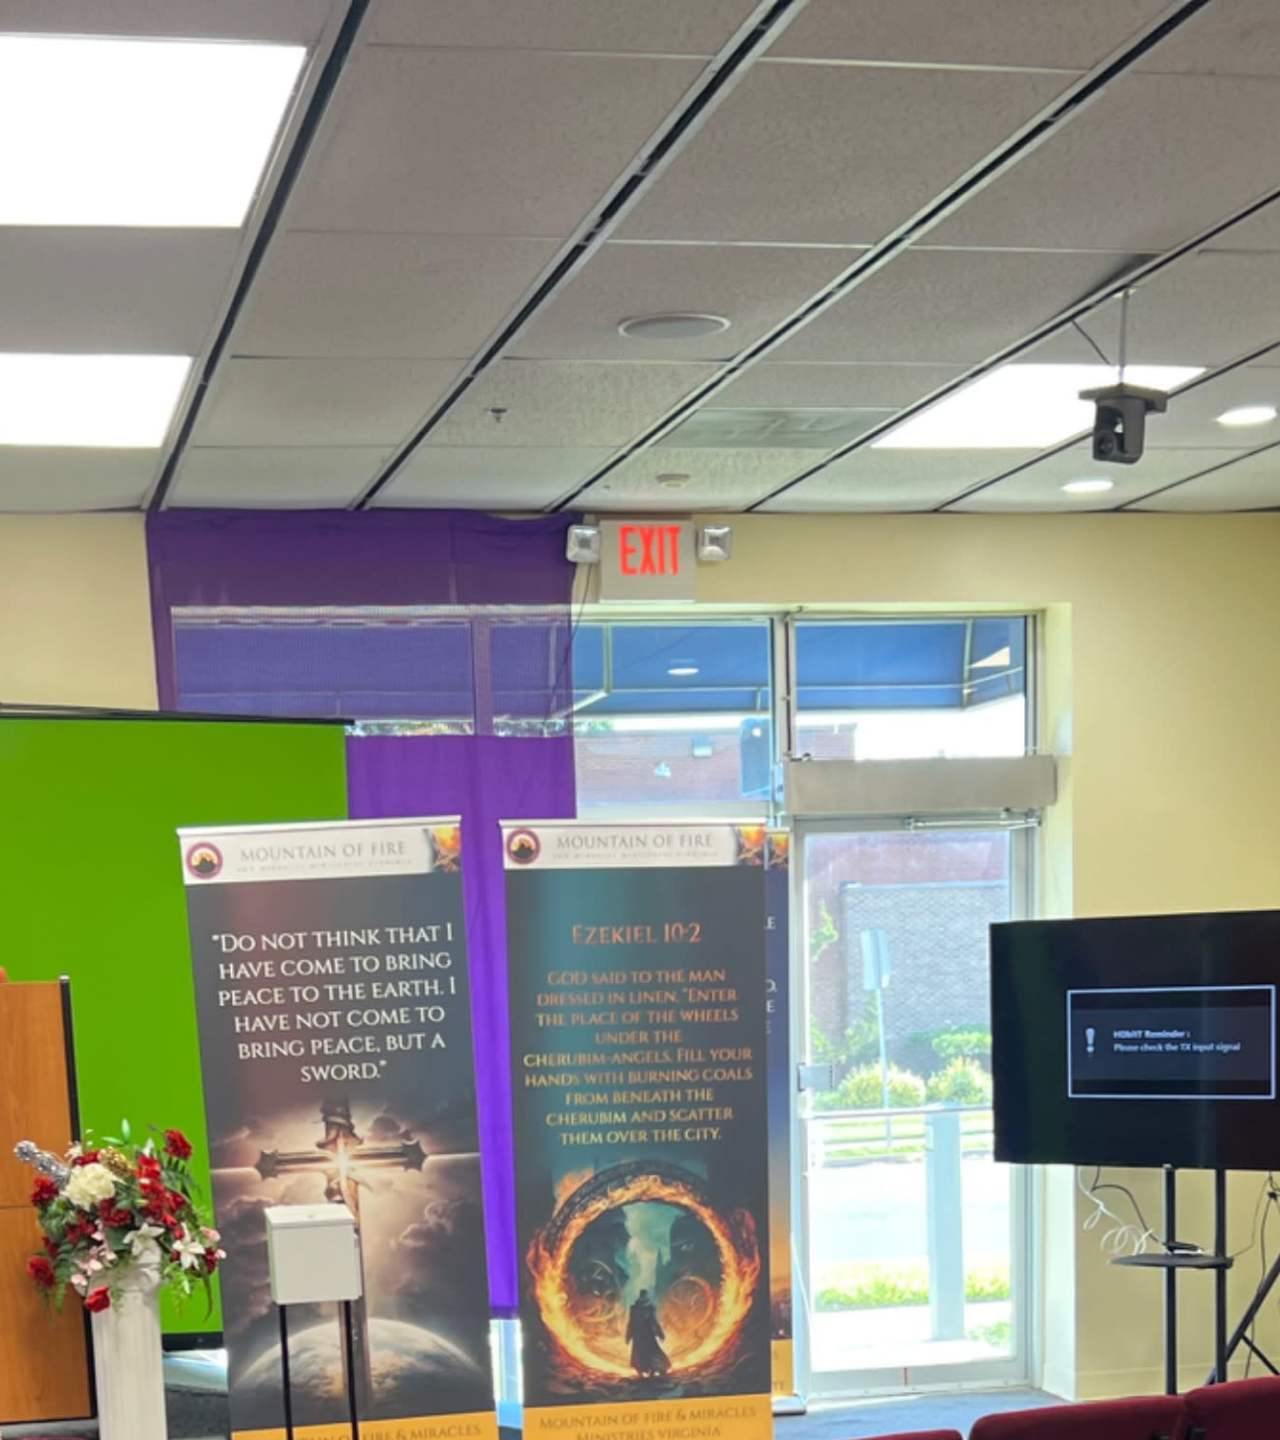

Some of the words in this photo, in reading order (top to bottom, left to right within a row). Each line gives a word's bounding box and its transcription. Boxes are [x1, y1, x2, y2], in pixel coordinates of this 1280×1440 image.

[619, 524, 681, 576] EXIT
[556, 834, 647, 849] MOUNTAIN
[652, 833, 673, 849] OF
[679, 832, 713, 848] FIRE
[240, 845, 337, 863] MOUNTAIN
[342, 843, 362, 858] OF
[371, 841, 406, 856] FIRE
[261, 932, 308, 951] NOT
[312, 929, 381, 948] THINK
[386, 925, 440, 944] THAT
[446, 922, 454, 943] I
[571, 923, 656, 945] EZEKIEL
[219, 961, 275, 981] HAVE
[281, 958, 345, 977] COME
[350, 955, 380, 973] TO
[386, 952, 452, 972] BRING
[547, 970, 587, 985] GOD
[592, 970, 626, 985] SAID
[631, 970, 652, 984] TO
[655, 969, 684, 983] THE
[688, 968, 726, 982] MAN
[218, 985, 284, 1007] PEACE
[290, 984, 318, 1004] TO
[324, 982, 366, 1001] THE
[371, 979, 444, 998] EARTH.
[448, 975, 456, 995] I
[536, 991, 602, 1007] DRESSED
[607, 991, 625, 1005] IN
[234, 1013, 290, 1033] HAVE
[296, 1010, 341, 1030] NOT
[346, 1008, 411, 1027] COME
[415, 1005, 445, 1024] TO
[535, 1012, 566, 1027] THE
[571, 1011, 617, 1026] PLACE
[621, 1011, 641, 1025] OF
[647, 1010, 675, 1024] THE
[679, 1008, 739, 1022] WHEELS
[238, 1038, 305, 1060] BRING
[310, 1036, 381, 1057] PEACE,
[386, 1032, 426, 1052] BUT
[430, 1030, 447, 1050] A
[595, 1030, 650, 1045] UNDER
[653, 1029, 683, 1043] THE
[676, 1048, 705, 1063] FILL
[709, 1047, 753, 1062] YOUR
[1113, 1043, 1139, 1052] Please
[1140, 1042, 1163, 1052] check
[1165, 1042, 1179, 1051] the
[1180, 1043, 1192, 1051] TX
[1193, 1042, 1214, 1053] input
[1216, 1042, 1241, 1053] signal
[524, 1072, 580, 1088] HANDS
[584, 1071, 624, 1085] WITH
[628, 1069, 699, 1085] BURNING
[702, 1067, 753, 1081] COALS
[565, 1092, 609, 1106] FROM
[612, 1089, 682, 1105] BENEATH
[686, 1087, 715, 1102] THE
[545, 1111, 627, 1127] CHERUBIM
[630, 1110, 667, 1124] AND
[670, 1107, 734, 1122] SCATTER
[559, 1131, 603, 1147] THEM
[606, 1129, 648, 1144] OVER
[653, 1128, 683, 1143] THE
[539, 1414, 618, 1429] MOUNTAIN
[622, 1412, 639, 1425] OF
[643, 1409, 672, 1423] FIRE
[675, 1408, 686, 1421] &
[689, 1405, 756, 1421] MIRACLES
[396, 1429, 407, 1440] &
[410, 1424, 481, 1440] MIRACLES
[657, 1426, 721, 1440] VIRGINIA
